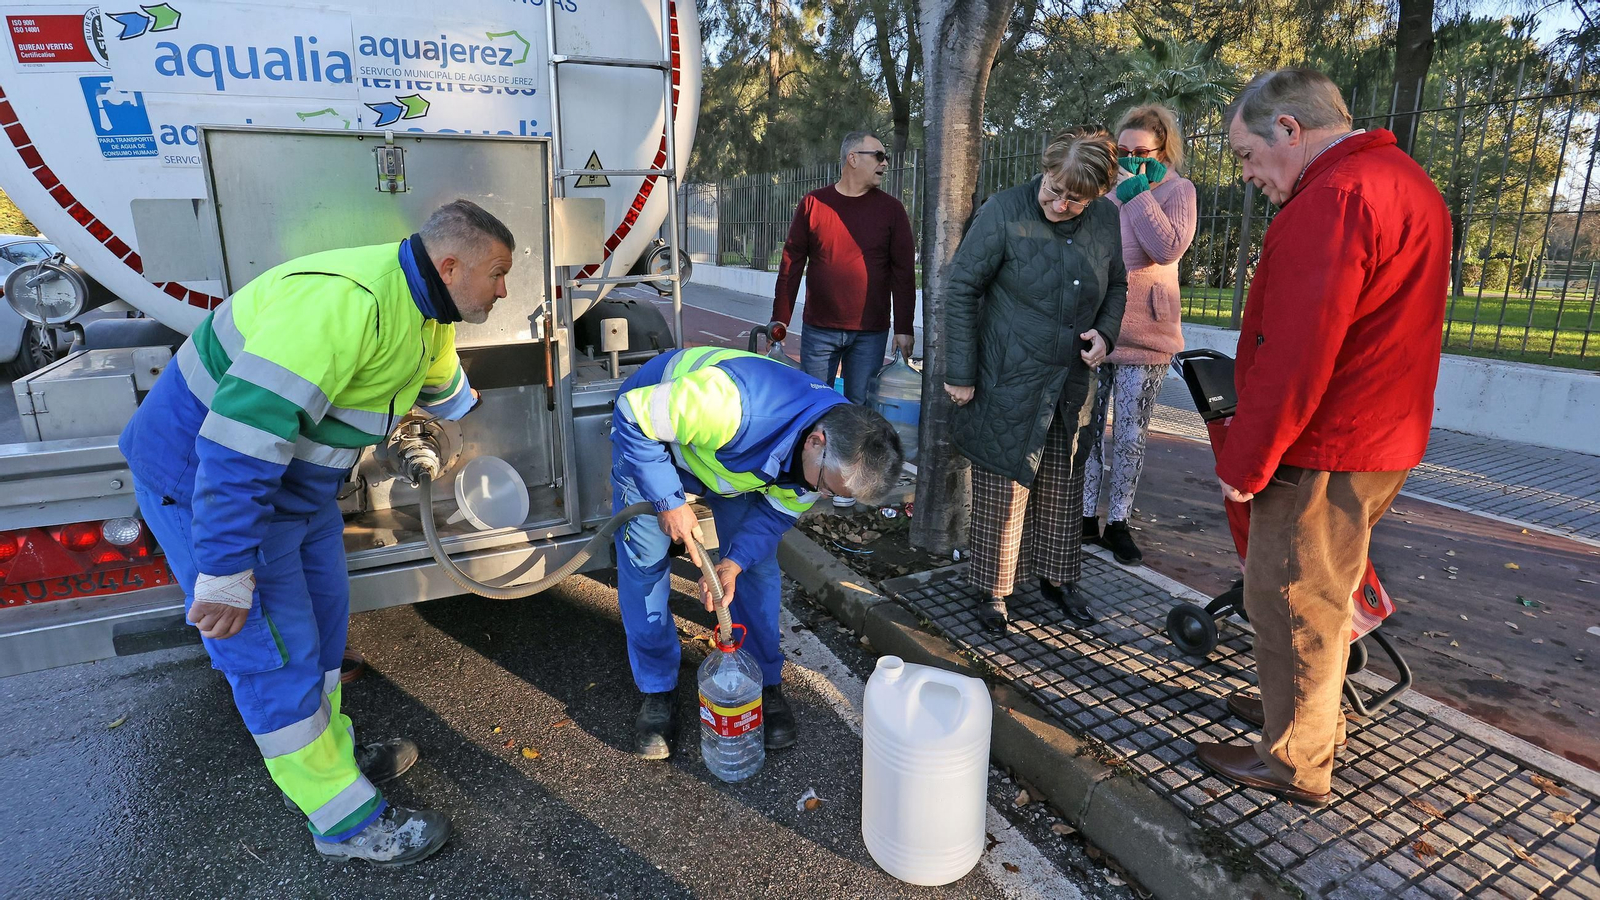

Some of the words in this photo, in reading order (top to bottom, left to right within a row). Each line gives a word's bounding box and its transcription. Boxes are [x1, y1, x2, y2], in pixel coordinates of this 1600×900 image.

[18, 43, 45, 51] BUREAU
[45, 42, 74, 50] VERITAS
[359, 34, 514, 69] aquajerez
[155, 36, 354, 91] aqualia
[359, 66, 402, 77] SERVICIO
[404, 68, 451, 80] MUNICIPAL
[454, 72, 467, 81] DE
[469, 73, 497, 84] AGUAS
[498, 75, 509, 84] DE
[510, 76, 534, 86] JEREZ
[164, 155, 201, 164] SERVICI
